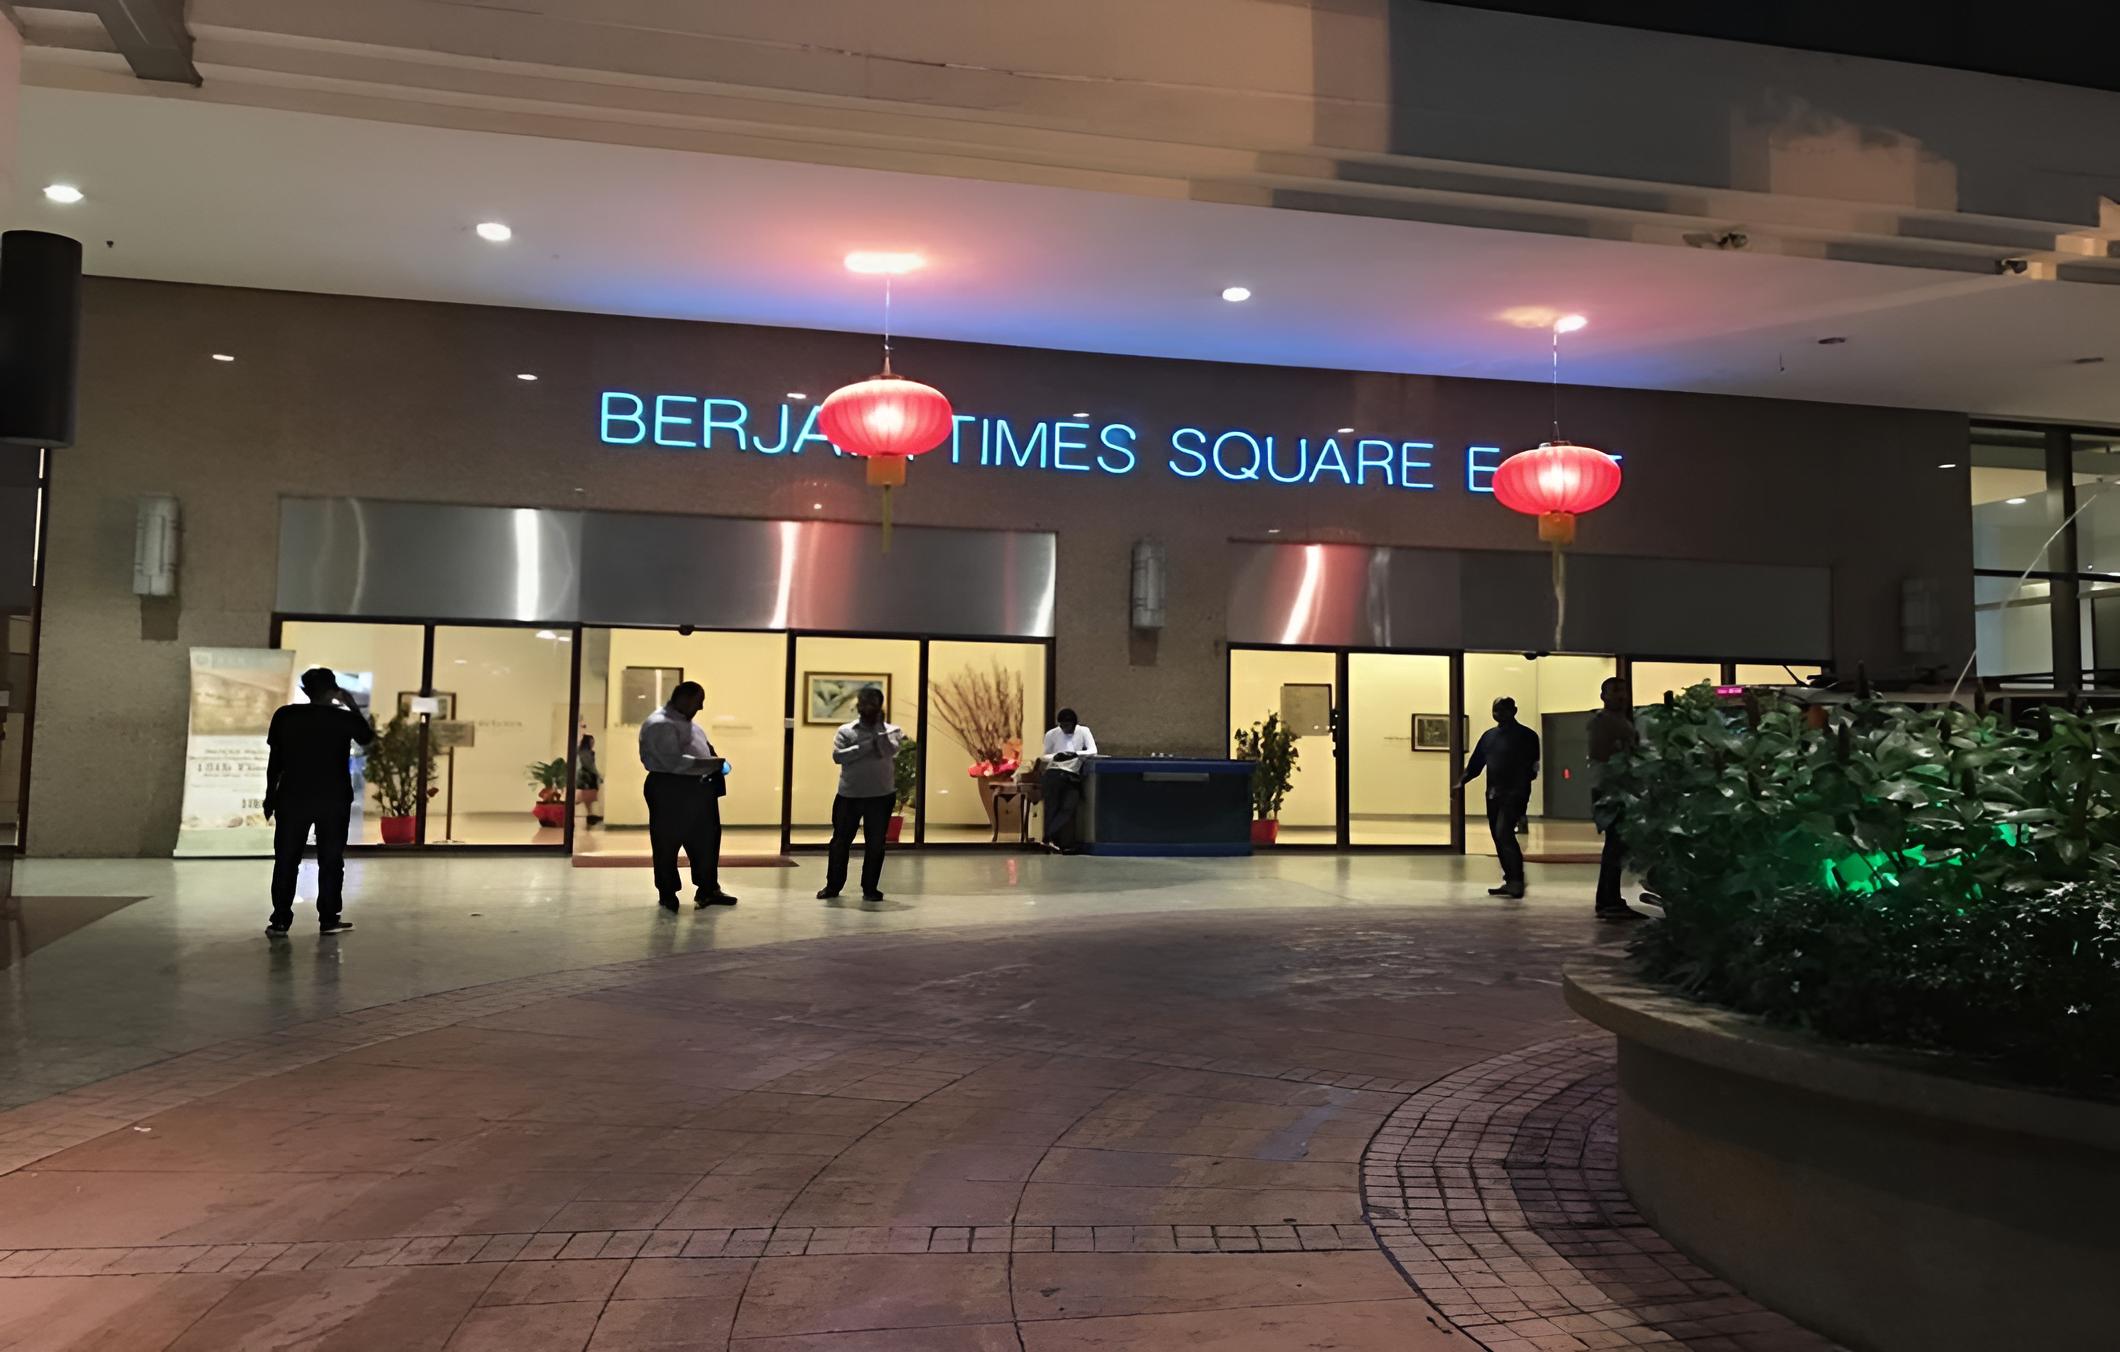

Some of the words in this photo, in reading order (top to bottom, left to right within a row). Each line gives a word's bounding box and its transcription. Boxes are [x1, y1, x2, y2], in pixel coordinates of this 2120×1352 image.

[600, 391, 914, 462] BERJA
[951, 414, 1136, 473] TIMES
[1168, 428, 1434, 488] SQUARE
